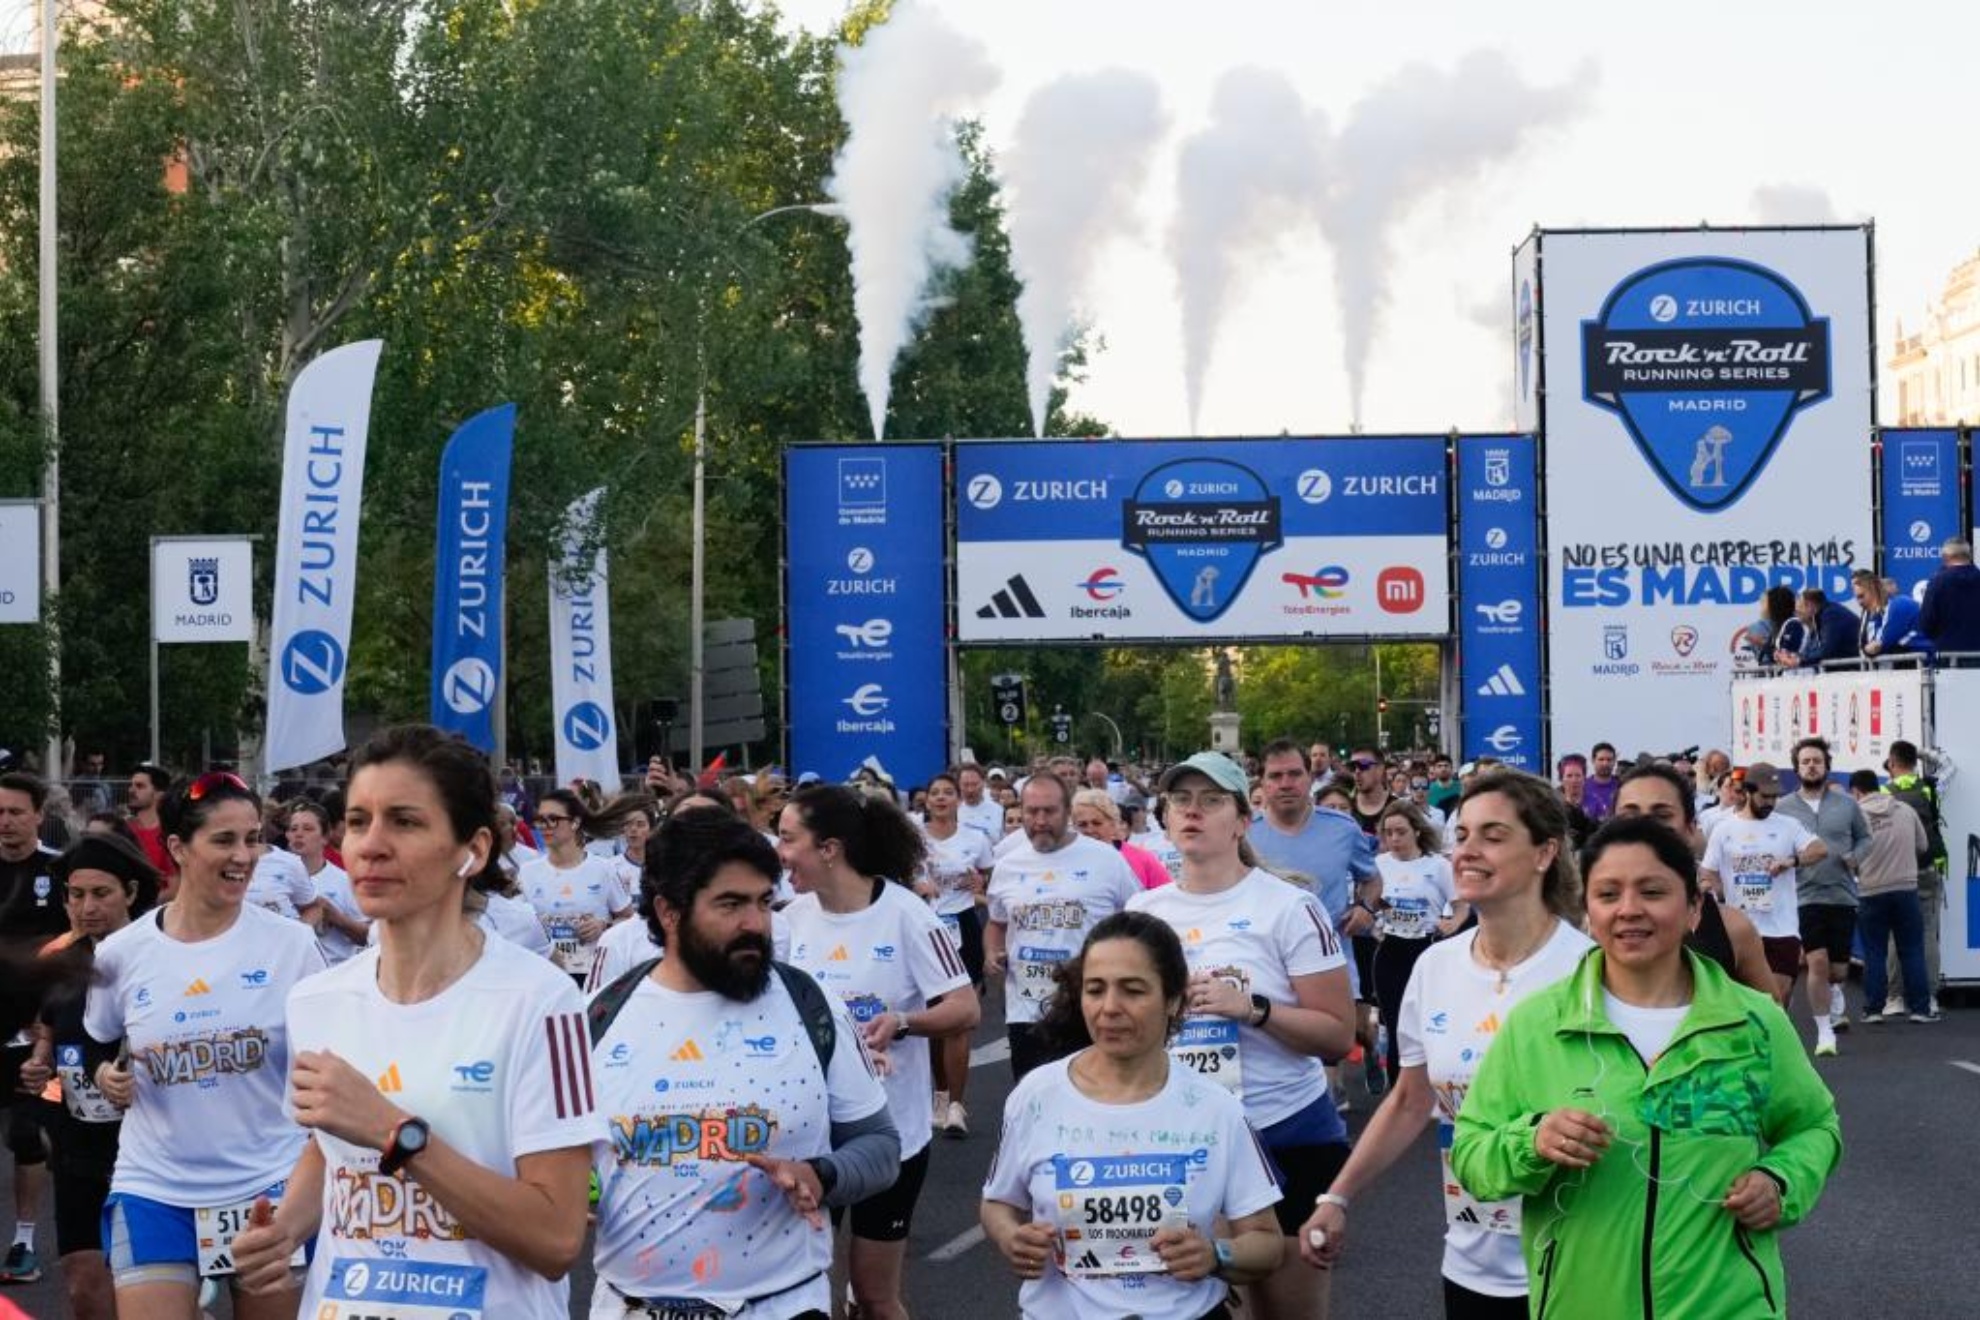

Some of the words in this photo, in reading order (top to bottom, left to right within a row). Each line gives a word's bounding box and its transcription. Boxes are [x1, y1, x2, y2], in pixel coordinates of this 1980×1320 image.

[1685, 299, 1761, 317] ZURICH
[1604, 341, 1700, 365] Rock
[1729, 339, 1811, 363] Roll
[1623, 369, 1714, 381] RUNNING
[1719, 367, 1790, 380] SERIES
[1668, 399, 1747, 412] MADRID
[1012, 480, 1108, 501] ZURICH
[1187, 483, 1239, 495] ZURICH
[1342, 475, 1438, 496] ZURICH
[297, 424, 345, 608] ZURICH
[1135, 509, 1198, 526] Rock
[1217, 509, 1270, 525] Roll
[1147, 528, 1207, 537] RUNNING
[1210, 527, 1257, 536] SERIES
[457, 480, 491, 639] ZURICH
[1177, 548, 1230, 557] MADRID
[1469, 553, 1525, 567] ZURICH
[1562, 543, 1598, 568] NO
[1601, 544, 1630, 569] ES
[1633, 540, 1686, 568] UNA
[1689, 539, 1801, 568] CARRERA
[1807, 534, 1855, 568] MÁS
[1893, 547, 1943, 559] ZURIC
[826, 579, 896, 595] ZURICH
[1562, 567, 1632, 607] ES
[1641, 564, 1855, 606] MADRID
[174, 613, 232, 627] MADRID
[1069, 604, 1132, 620] Ibercaja
[836, 718, 896, 734] Ibercaja
[148, 1036, 266, 1087] MADRID
[610, 1113, 770, 1167] MADRID
[1102, 1162, 1172, 1180] ZURICH
[331, 1171, 461, 1240] MADR
[1084, 1194, 1162, 1224] 58498
[376, 1240, 407, 1258] 0K
[375, 1270, 465, 1297] ZURICH
